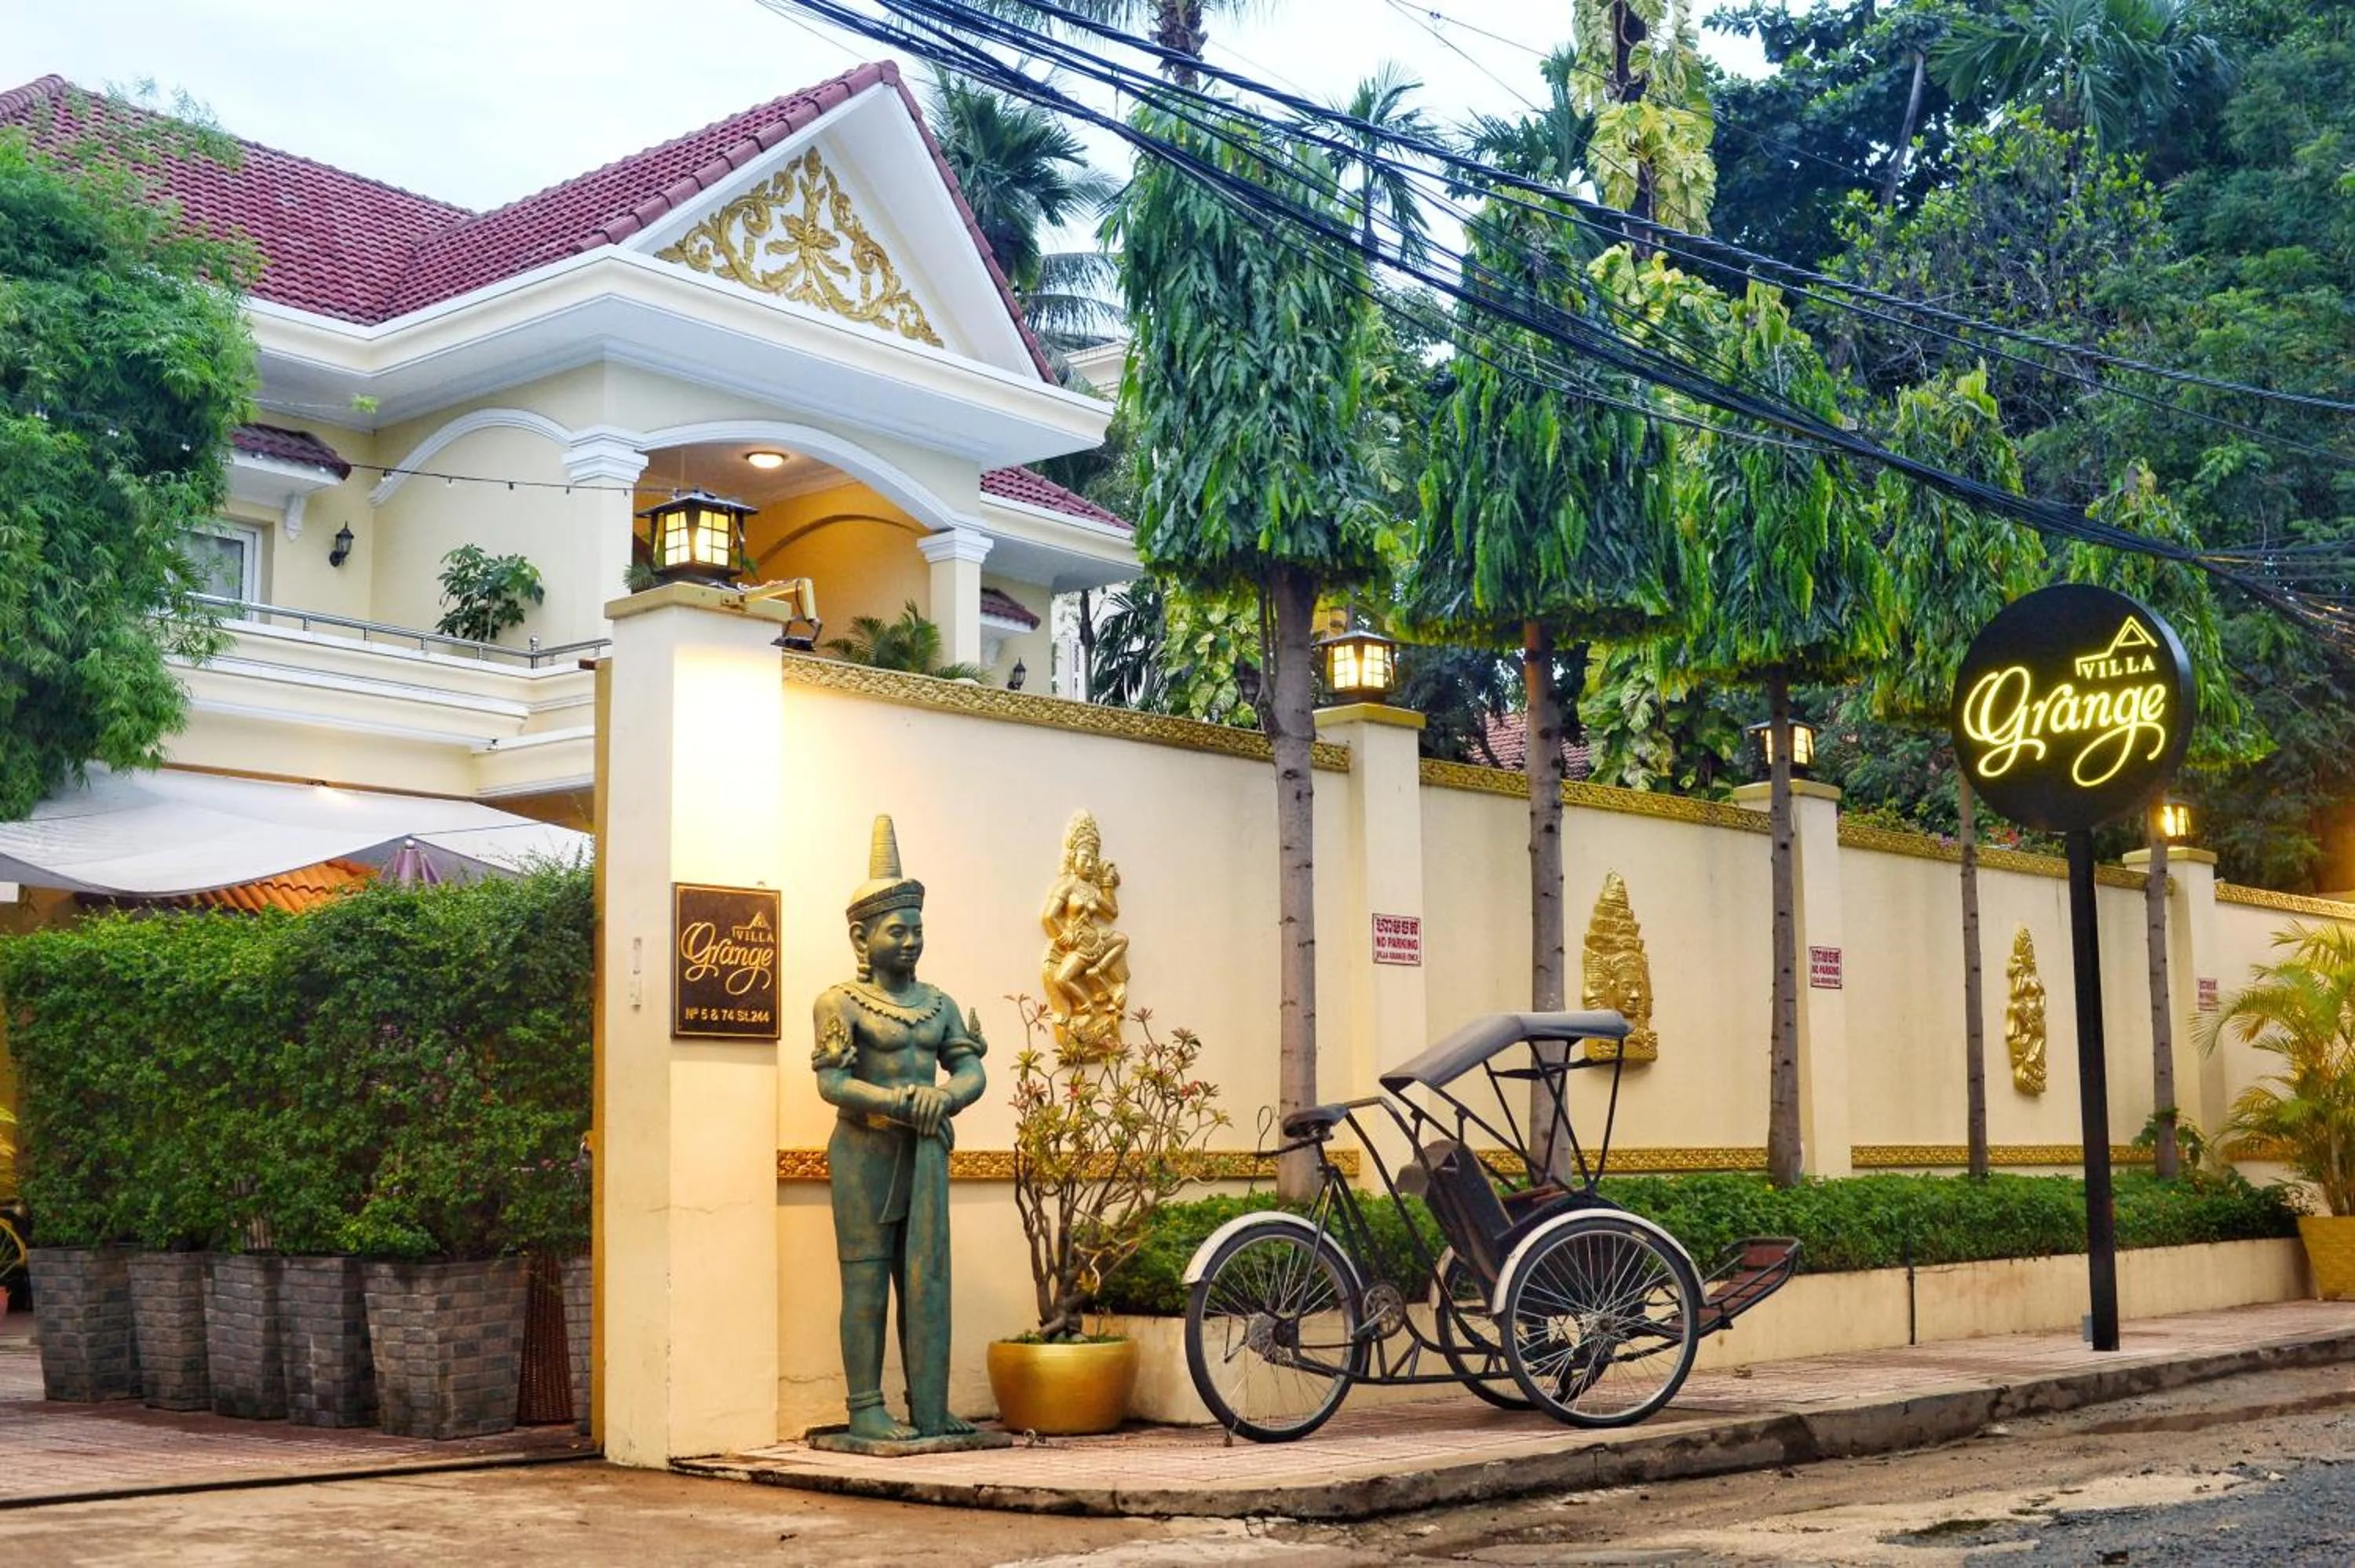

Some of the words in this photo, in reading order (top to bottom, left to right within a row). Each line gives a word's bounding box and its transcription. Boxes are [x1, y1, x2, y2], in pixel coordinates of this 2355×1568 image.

[2082, 655, 2156, 679] VILLA
[1963, 665, 2167, 787] Grange
[736, 931, 775, 943] VILLA
[1376, 936, 1386, 948] NO
[1388, 937, 1418, 950] PARKING
[681, 922, 773, 996] Grange
[701, 1009, 707, 1020] 5
[710, 1009, 718, 1021] &
[721, 1009, 733, 1021] 74
